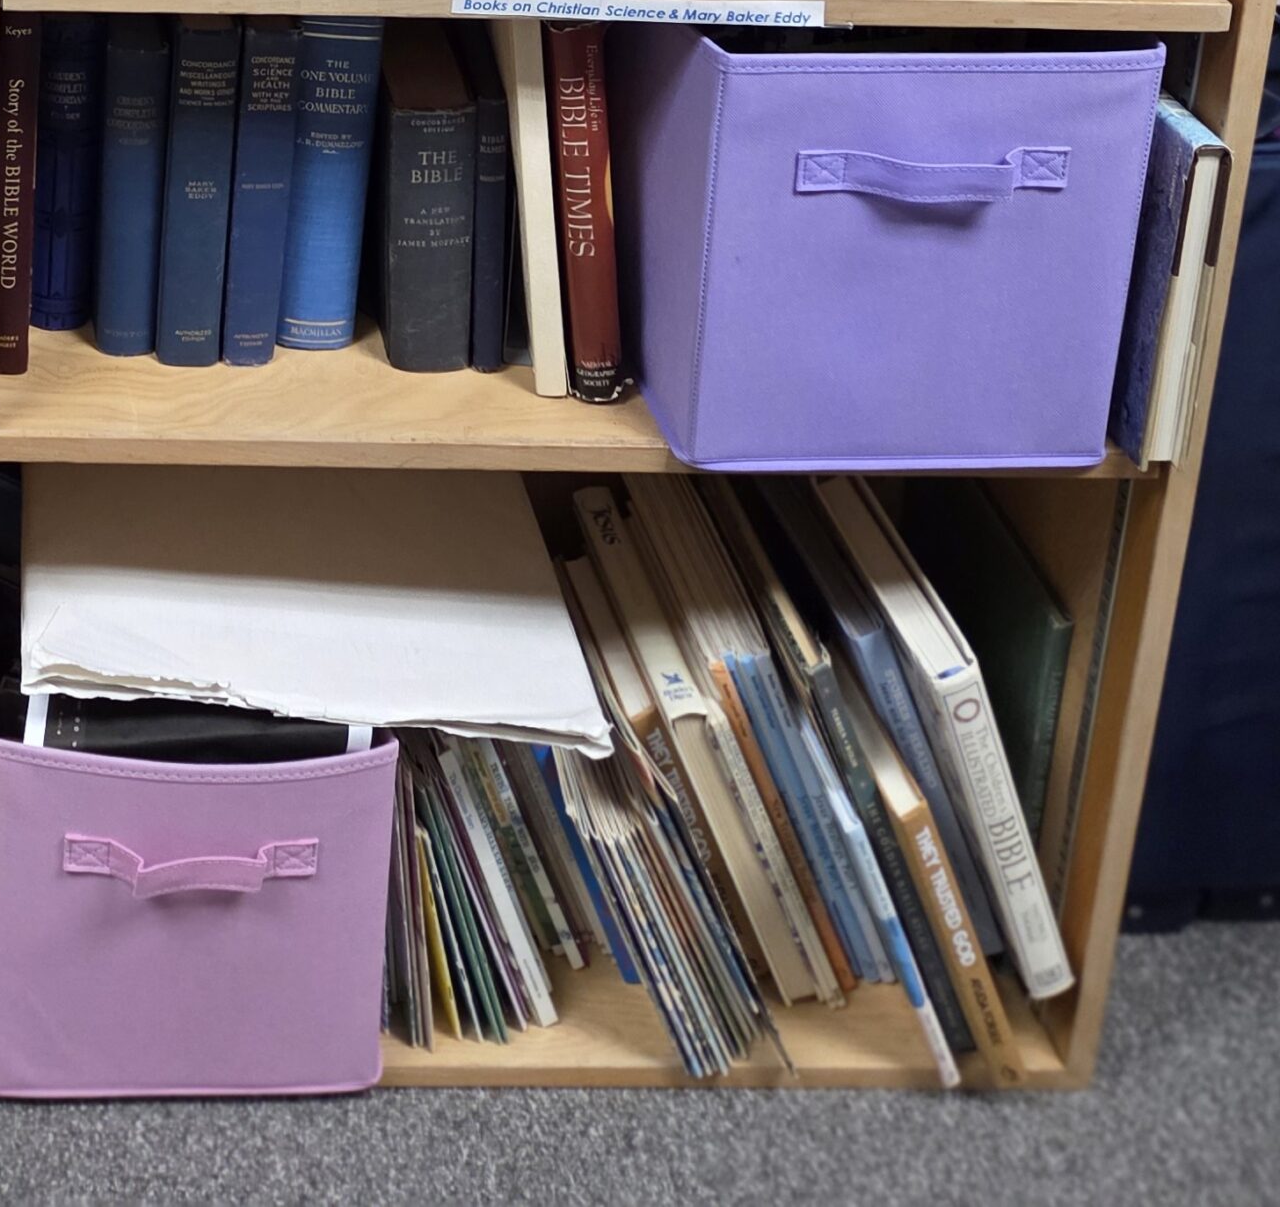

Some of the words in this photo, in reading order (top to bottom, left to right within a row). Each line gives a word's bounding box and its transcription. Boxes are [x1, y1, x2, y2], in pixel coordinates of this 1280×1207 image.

[464, 0, 508, 12] Books
[512, 2, 531, 12] on
[536, 1, 600, 17] Christian
[605, 5, 666, 19] Science
[669, 9, 679, 19] &
[683, 9, 720, 23] Mary
[726, 11, 770, 23] Baker
[774, 12, 811, 26] Eddy
[5, 25, 32, 38] Keyes
[181, 59, 236, 69] CONCORDANCE
[251, 57, 296, 65] CONCORDANCE
[326, 60, 350, 69] THE
[252, 69, 293, 77] SCIENCE
[253, 81, 290, 89] HEALTH
[316, 87, 356, 99] BIBLE
[7, 79, 25, 116] Story
[247, 104, 292, 112] SCRIPTURES
[559, 76, 589, 157] BIBLE
[6, 119, 24, 135] of
[6, 138, 23, 163] the
[418, 150, 458, 166] THE
[411, 166, 464, 184] BIBLE
[3, 165, 21, 216] BIBLE
[563, 168, 595, 258] TIMES
[0, 222, 19, 289] WORLD
[289, 326, 342, 337] MACMILLAN
[988, 815, 1036, 896] BIBLE
[915, 826, 941, 869] THEY
[949, 928, 976, 968] GOD
